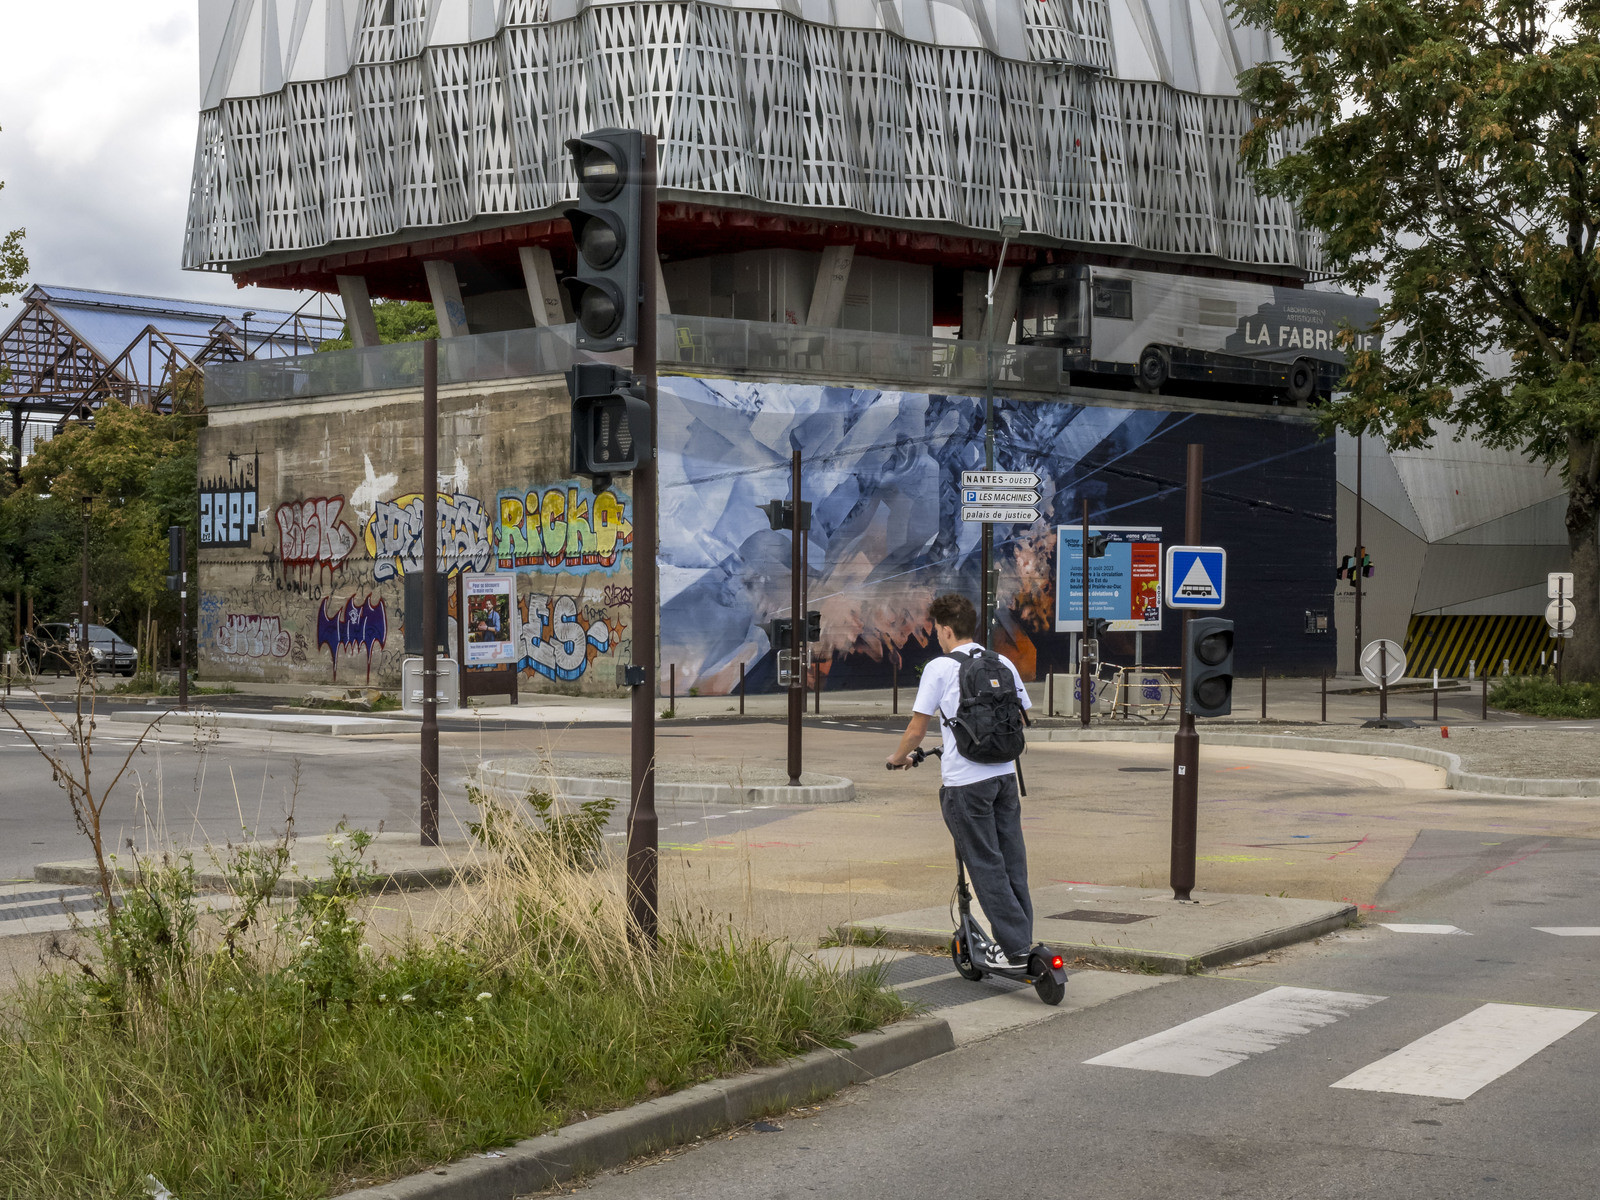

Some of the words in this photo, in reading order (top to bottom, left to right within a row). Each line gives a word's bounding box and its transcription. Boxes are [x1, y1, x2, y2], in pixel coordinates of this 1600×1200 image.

[1245, 321, 1271, 346] LA
[966, 475, 1032, 484] NANTES-OUEST
[968, 492, 975, 501] P
[979, 493, 993, 501] LES
[993, 493, 1033, 502] MACHINES
[966, 510, 990, 519] palais
[1004, 511, 1032, 520] justice
[276, 578, 322, 601] ROMULO
